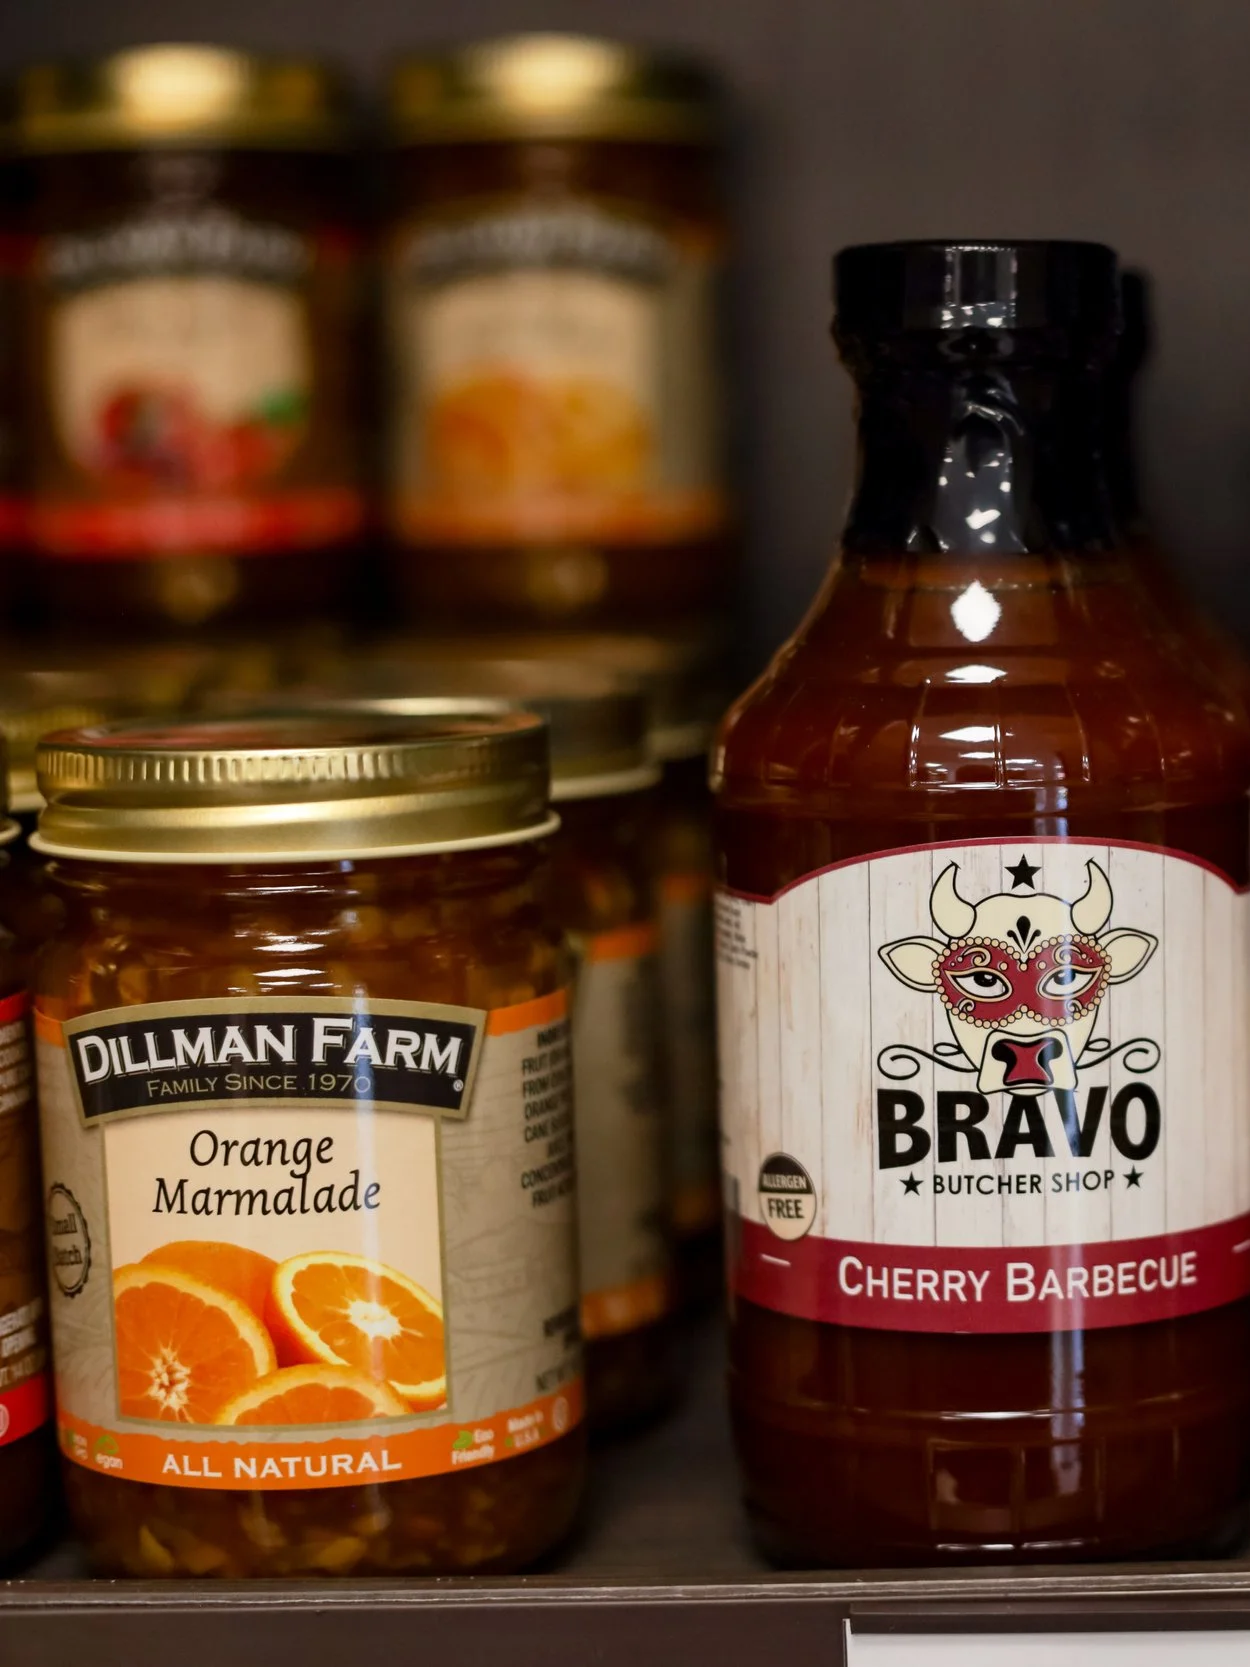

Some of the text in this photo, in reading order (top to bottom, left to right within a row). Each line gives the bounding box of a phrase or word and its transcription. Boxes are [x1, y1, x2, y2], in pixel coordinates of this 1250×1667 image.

[77, 1024, 296, 1083] DILLMAN
[312, 1017, 463, 1075] FARM
[147, 1073, 371, 1097] FAMILY SINCE 1970
[877, 1081, 1161, 1169] BRAVO
[189, 1130, 335, 1179] Orange
[152, 1169, 381, 1216] Marmalade
[763, 1173, 808, 1189] ALLERGEN
[933, 1170, 1115, 1195] BUTCHER SHOP
[767, 1197, 804, 1219] FREE
[839, 1251, 1198, 1303] CHERRY BARBECUE
[162, 1450, 403, 1478] ALL NATURAL
